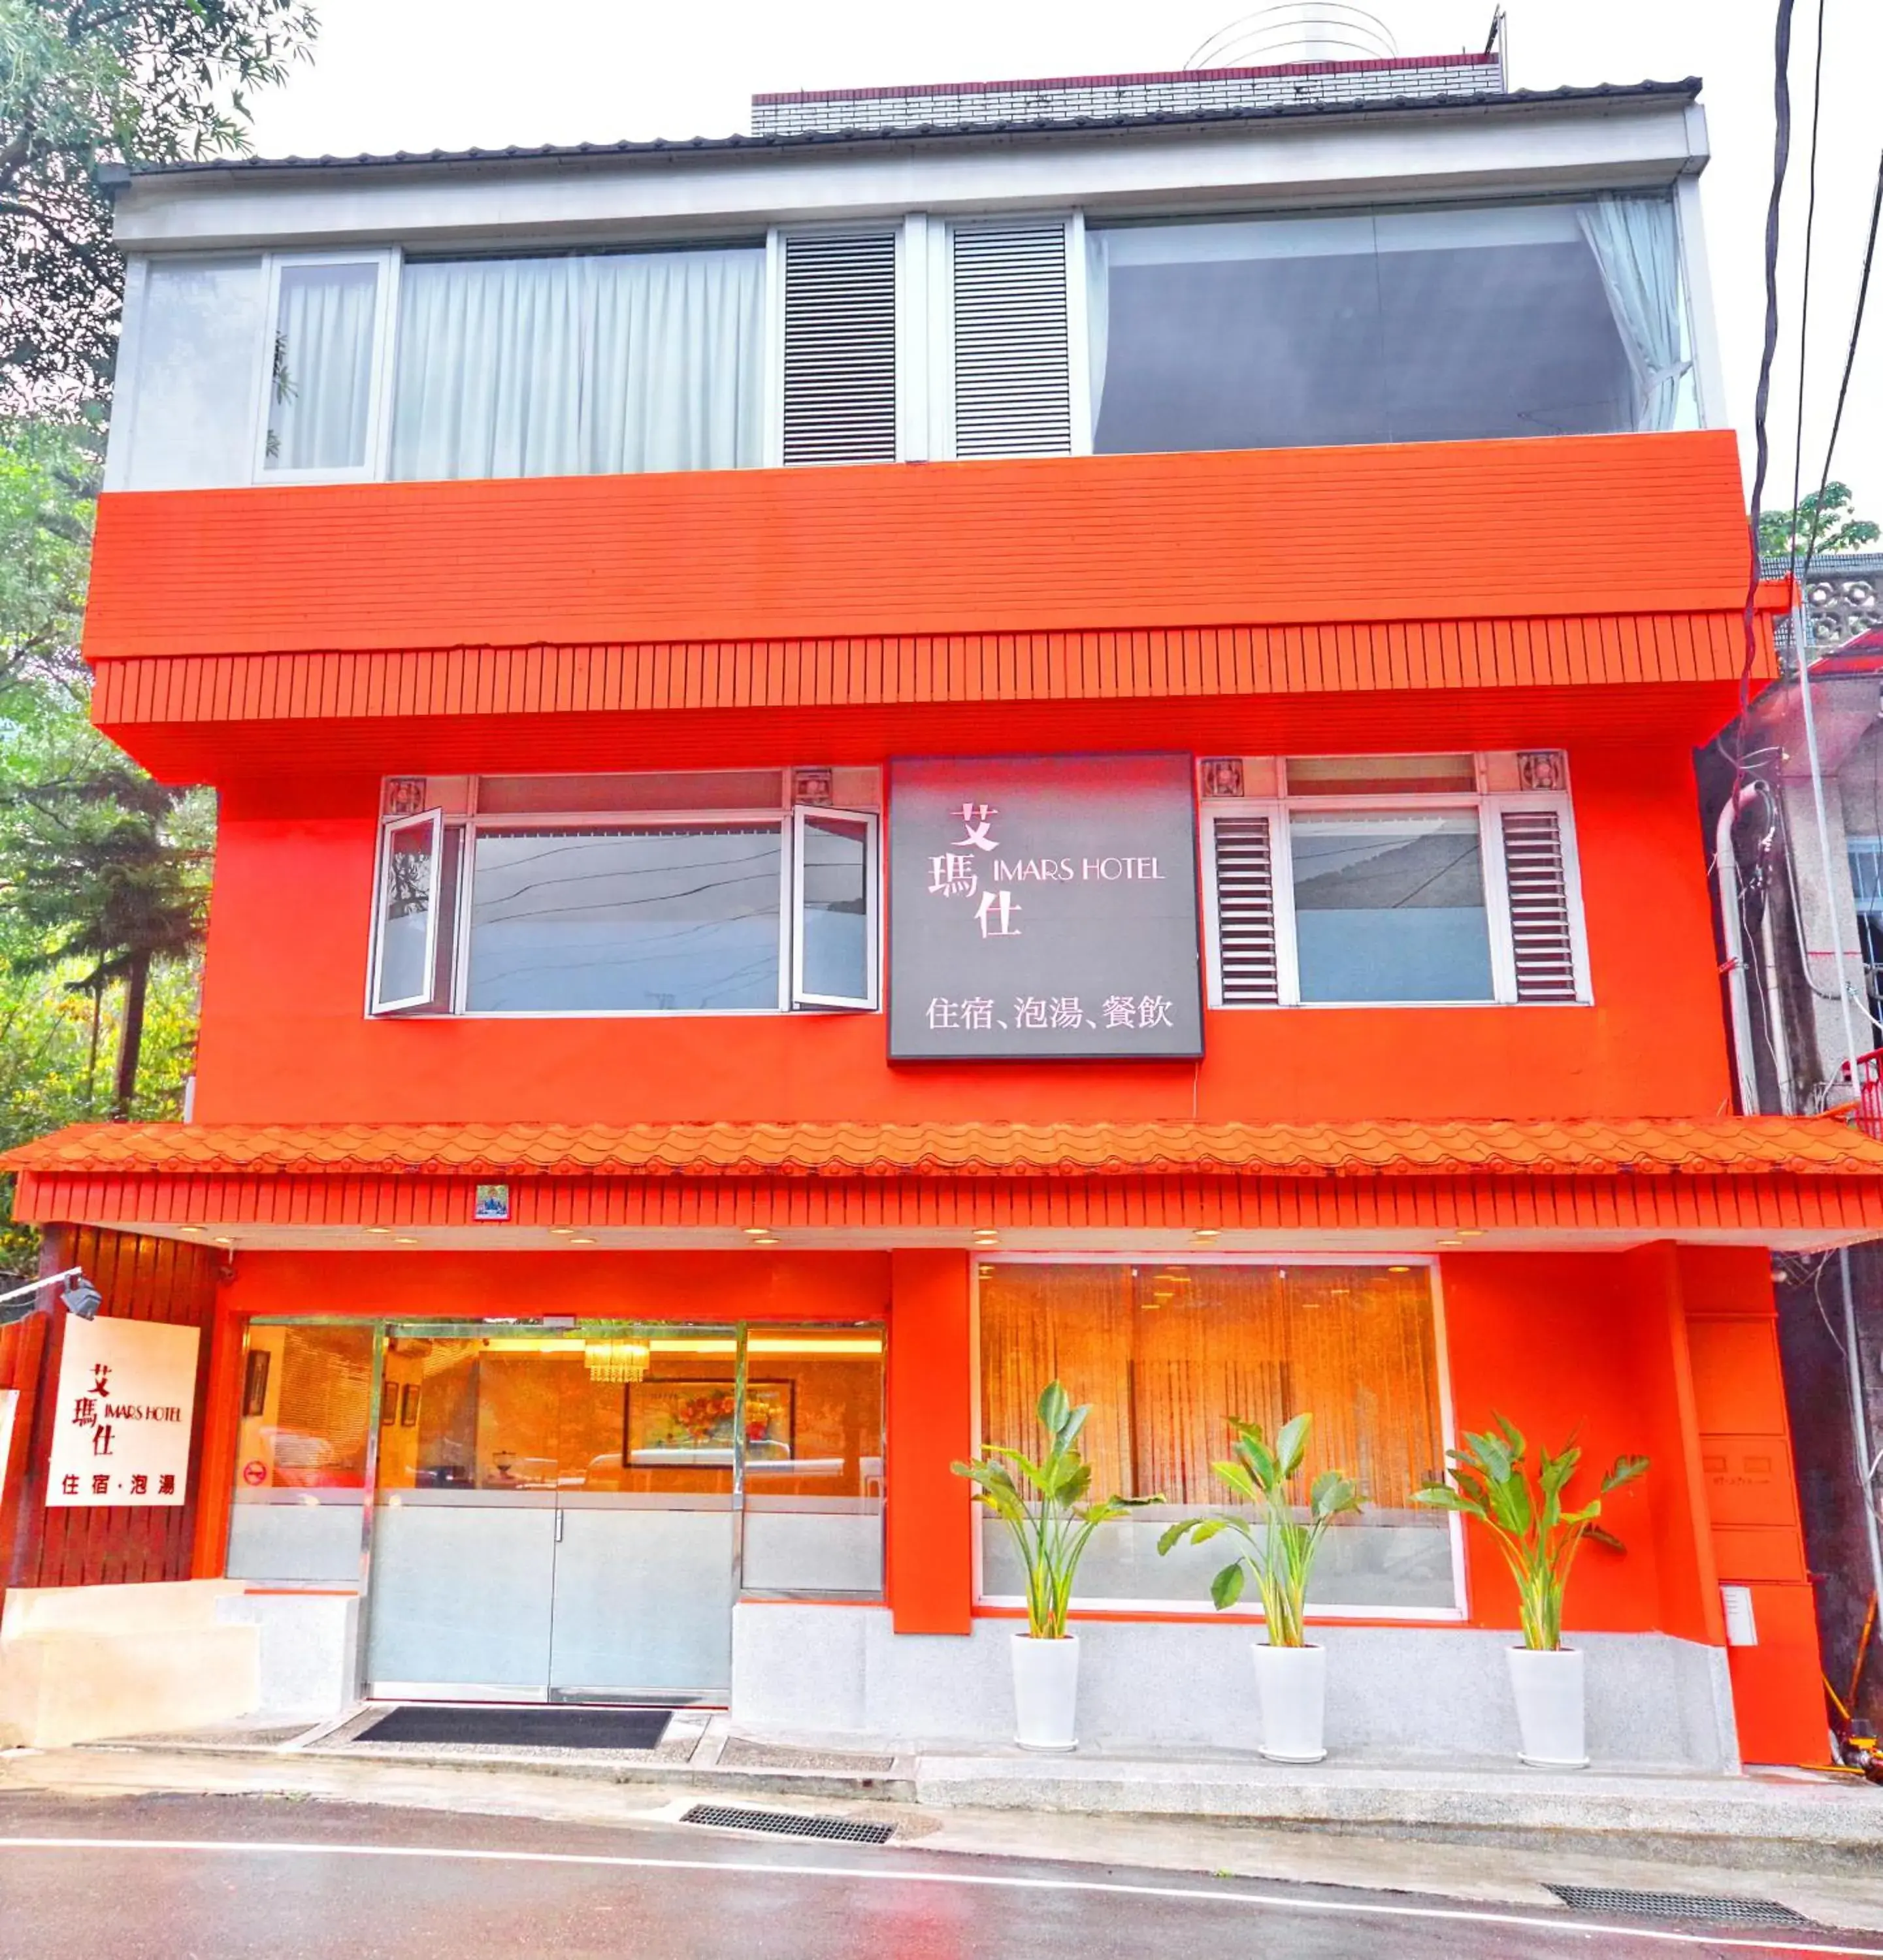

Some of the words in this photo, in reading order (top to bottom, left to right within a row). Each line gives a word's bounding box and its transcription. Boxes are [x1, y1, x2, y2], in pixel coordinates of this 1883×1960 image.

[928, 802, 1023, 939] 艾瑪仕
[993, 857, 1075, 882] IMARS
[1082, 857, 1167, 881] HOTEL
[71, 1363, 116, 1456] 艾瑪仕
[104, 1403, 143, 1420] IMARS
[145, 1405, 183, 1422] HOTEL
